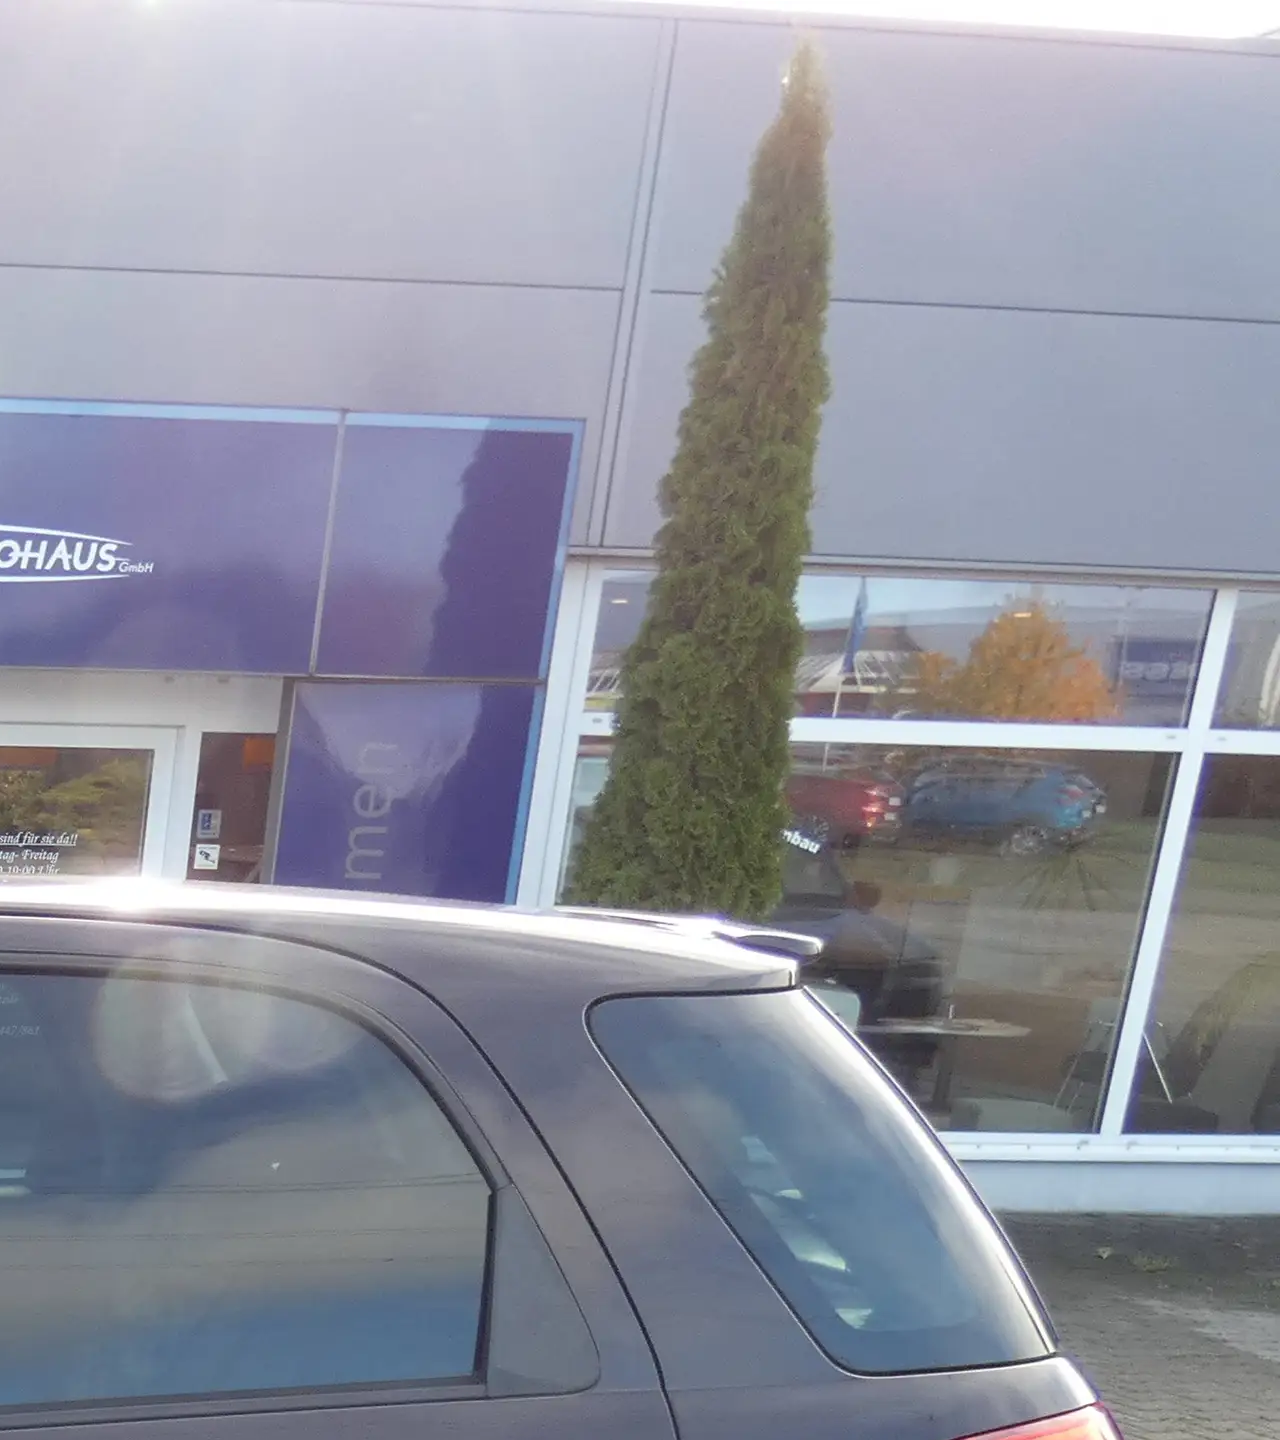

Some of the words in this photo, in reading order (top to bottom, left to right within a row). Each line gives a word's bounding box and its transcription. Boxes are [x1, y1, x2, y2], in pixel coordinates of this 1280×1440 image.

[118, 561, 155, 574] GmbH
[20, 832, 41, 847] für
[22, 849, 59, 863] Freitag
